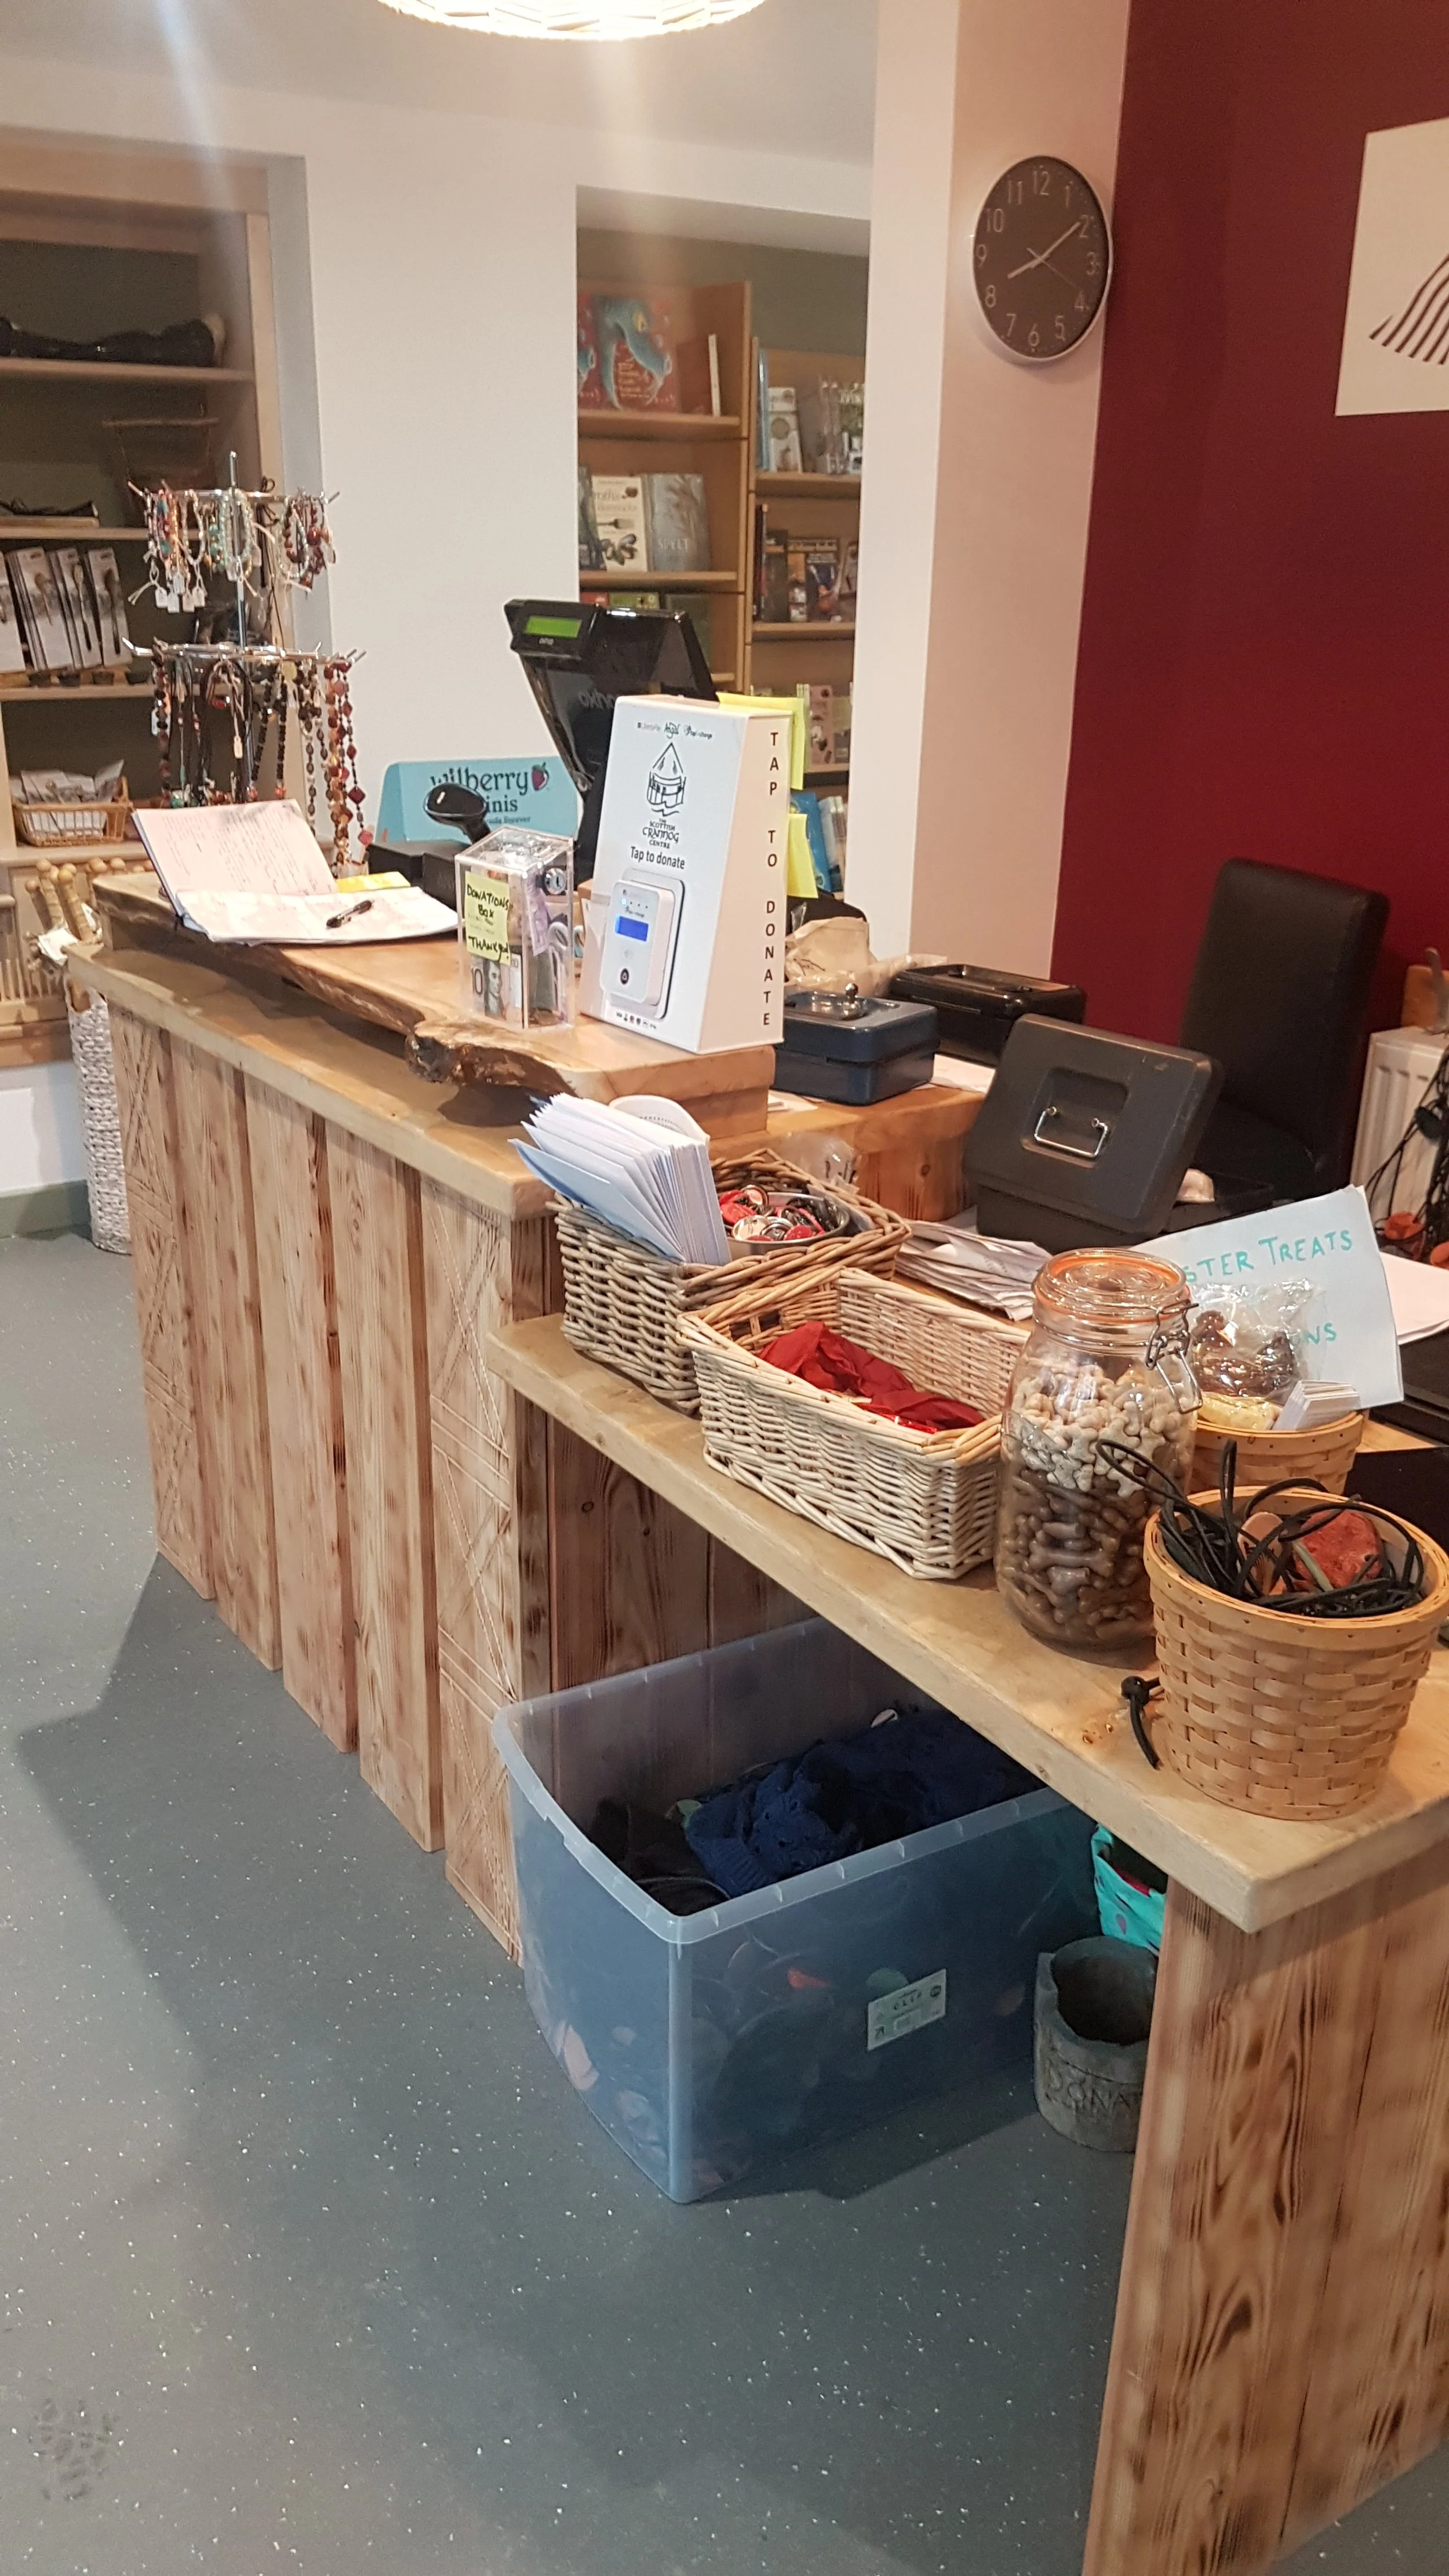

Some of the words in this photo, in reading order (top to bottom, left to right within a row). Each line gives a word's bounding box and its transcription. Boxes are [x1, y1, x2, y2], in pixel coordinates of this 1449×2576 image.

[1007, 180, 1022, 205] 11
[1033, 171, 1050, 196] 12
[1065, 185, 1071, 209] 1
[985, 208, 1004, 233] 10
[1079, 215, 1089, 238] 2
[975, 244, 986, 267] 9
[1086, 252, 1095, 275] 3
[985, 285, 997, 308] 8
[1073, 290, 1085, 312] 4
[1006, 314, 1017, 337] 7
[1028, 323, 1040, 347] 6
[1054, 315, 1065, 341] 5
[769, 732, 779, 796] TAP
[486, 795, 518, 812] inis
[649, 821, 676, 831] SCOTTISH
[649, 839, 670, 849] CENTRE
[767, 829, 777, 867] TO
[631, 846, 645, 863] Tap
[646, 850, 655, 862] to
[656, 851, 685, 869] donate
[467, 883, 509, 911] DONATIONS
[478, 904, 494, 918] BOX
[763, 901, 776, 1026] DONATE
[1183, 1251, 1254, 1283] STER
[1258, 1229, 1353, 1265] TREATS
